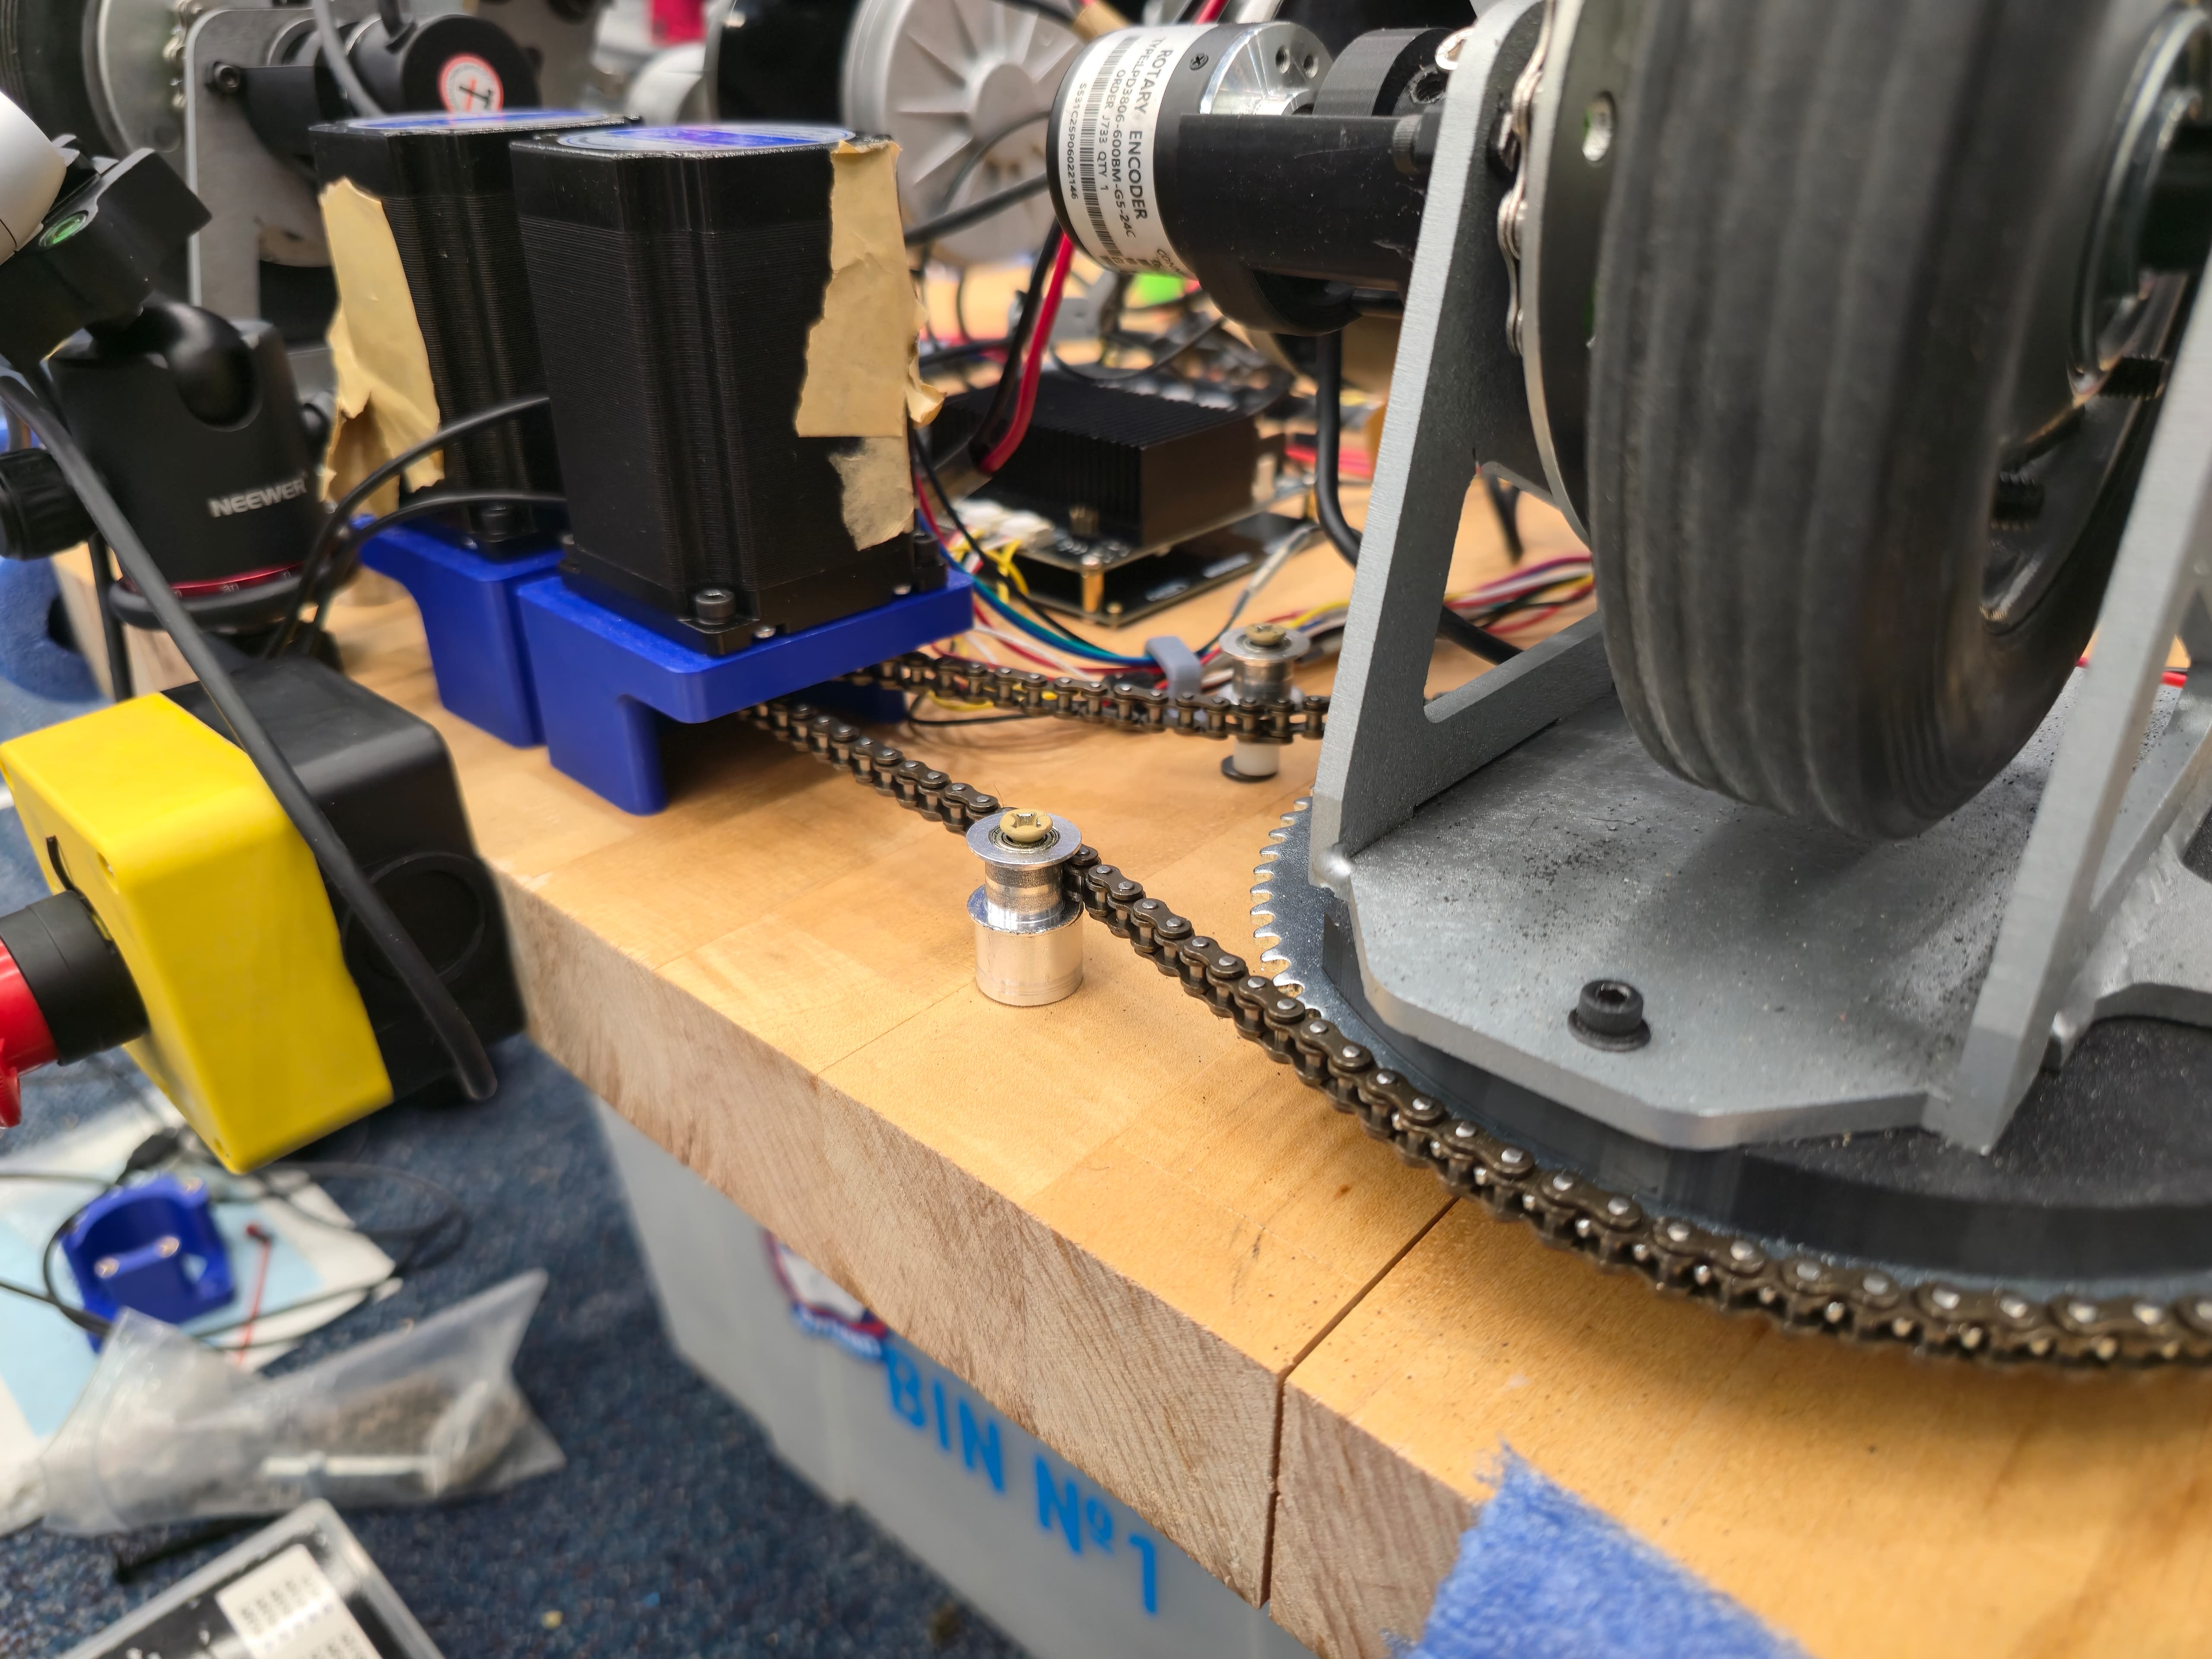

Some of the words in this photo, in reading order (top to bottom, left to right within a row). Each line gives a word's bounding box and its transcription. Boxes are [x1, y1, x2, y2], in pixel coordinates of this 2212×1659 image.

[1104, 70, 1125, 109] ORDER
[1135, 50, 1173, 114] ROTARY
[1099, 116, 1110, 144] J733
[1097, 151, 1107, 177] QTY
[1128, 130, 1148, 220] ENCODER
[209, 477, 308, 518] NEEWER
[886, 1346, 1005, 1493] BIN
